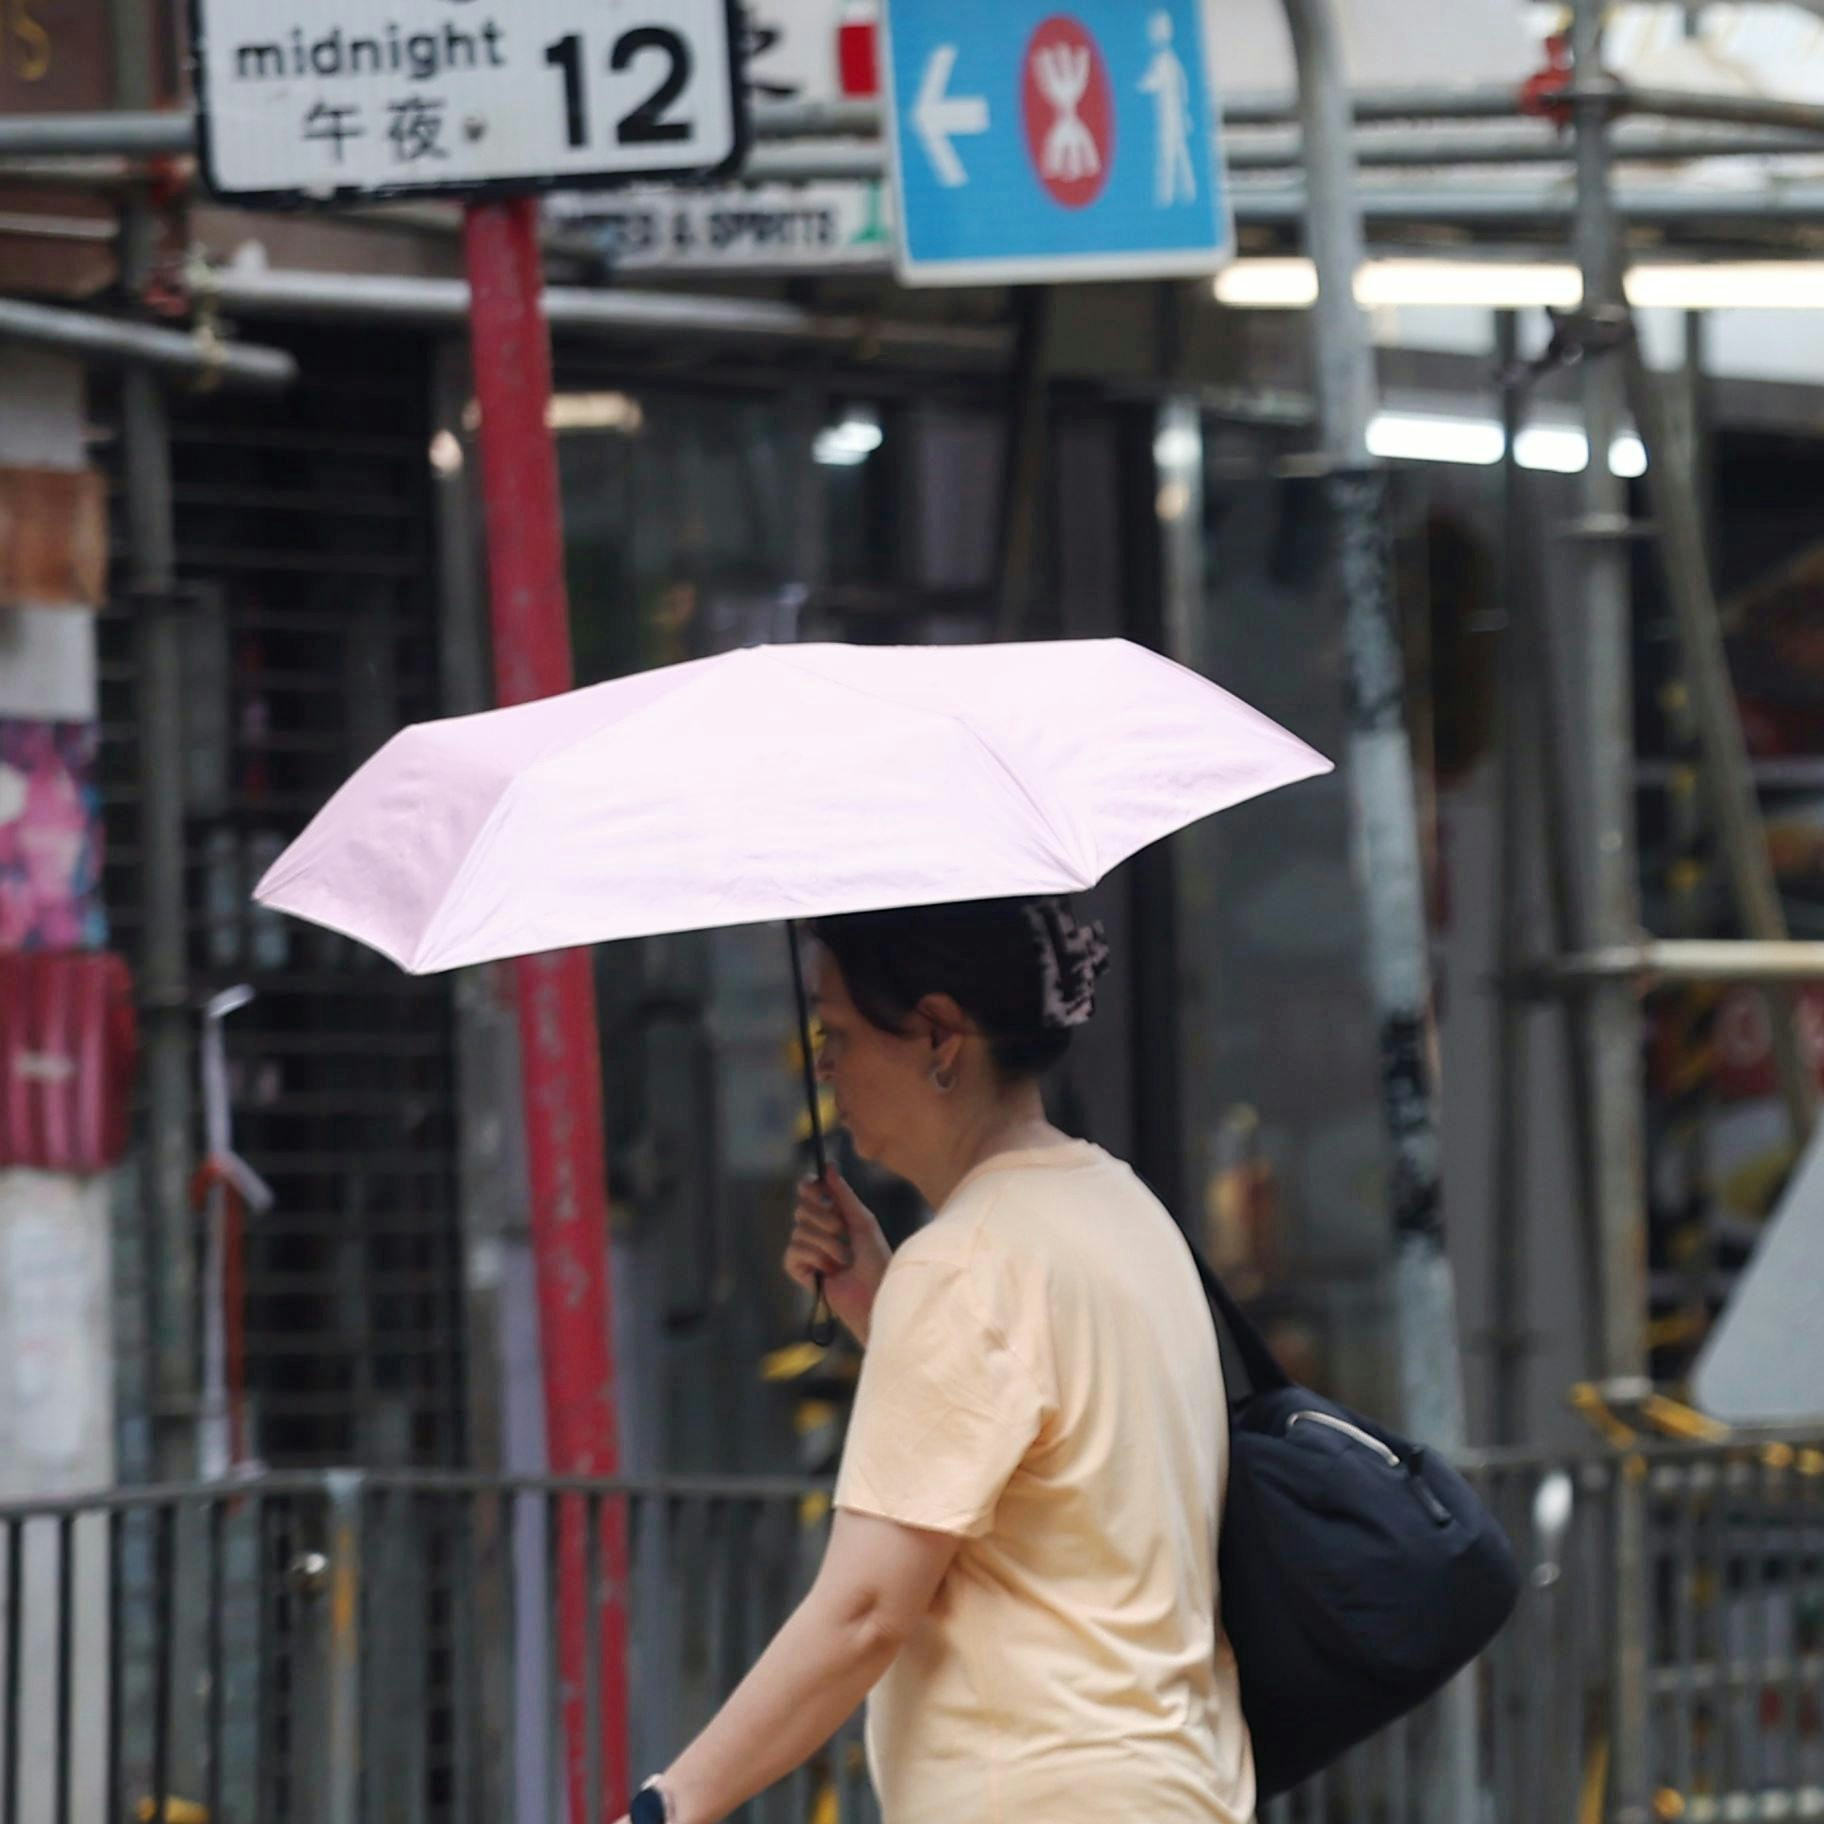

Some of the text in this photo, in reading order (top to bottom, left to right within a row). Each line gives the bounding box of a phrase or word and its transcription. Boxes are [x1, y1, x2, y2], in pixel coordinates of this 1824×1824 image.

[236, 21, 505, 80] midnight
[545, 26, 694, 149] 12
[304, 97, 451, 163] 午夜
